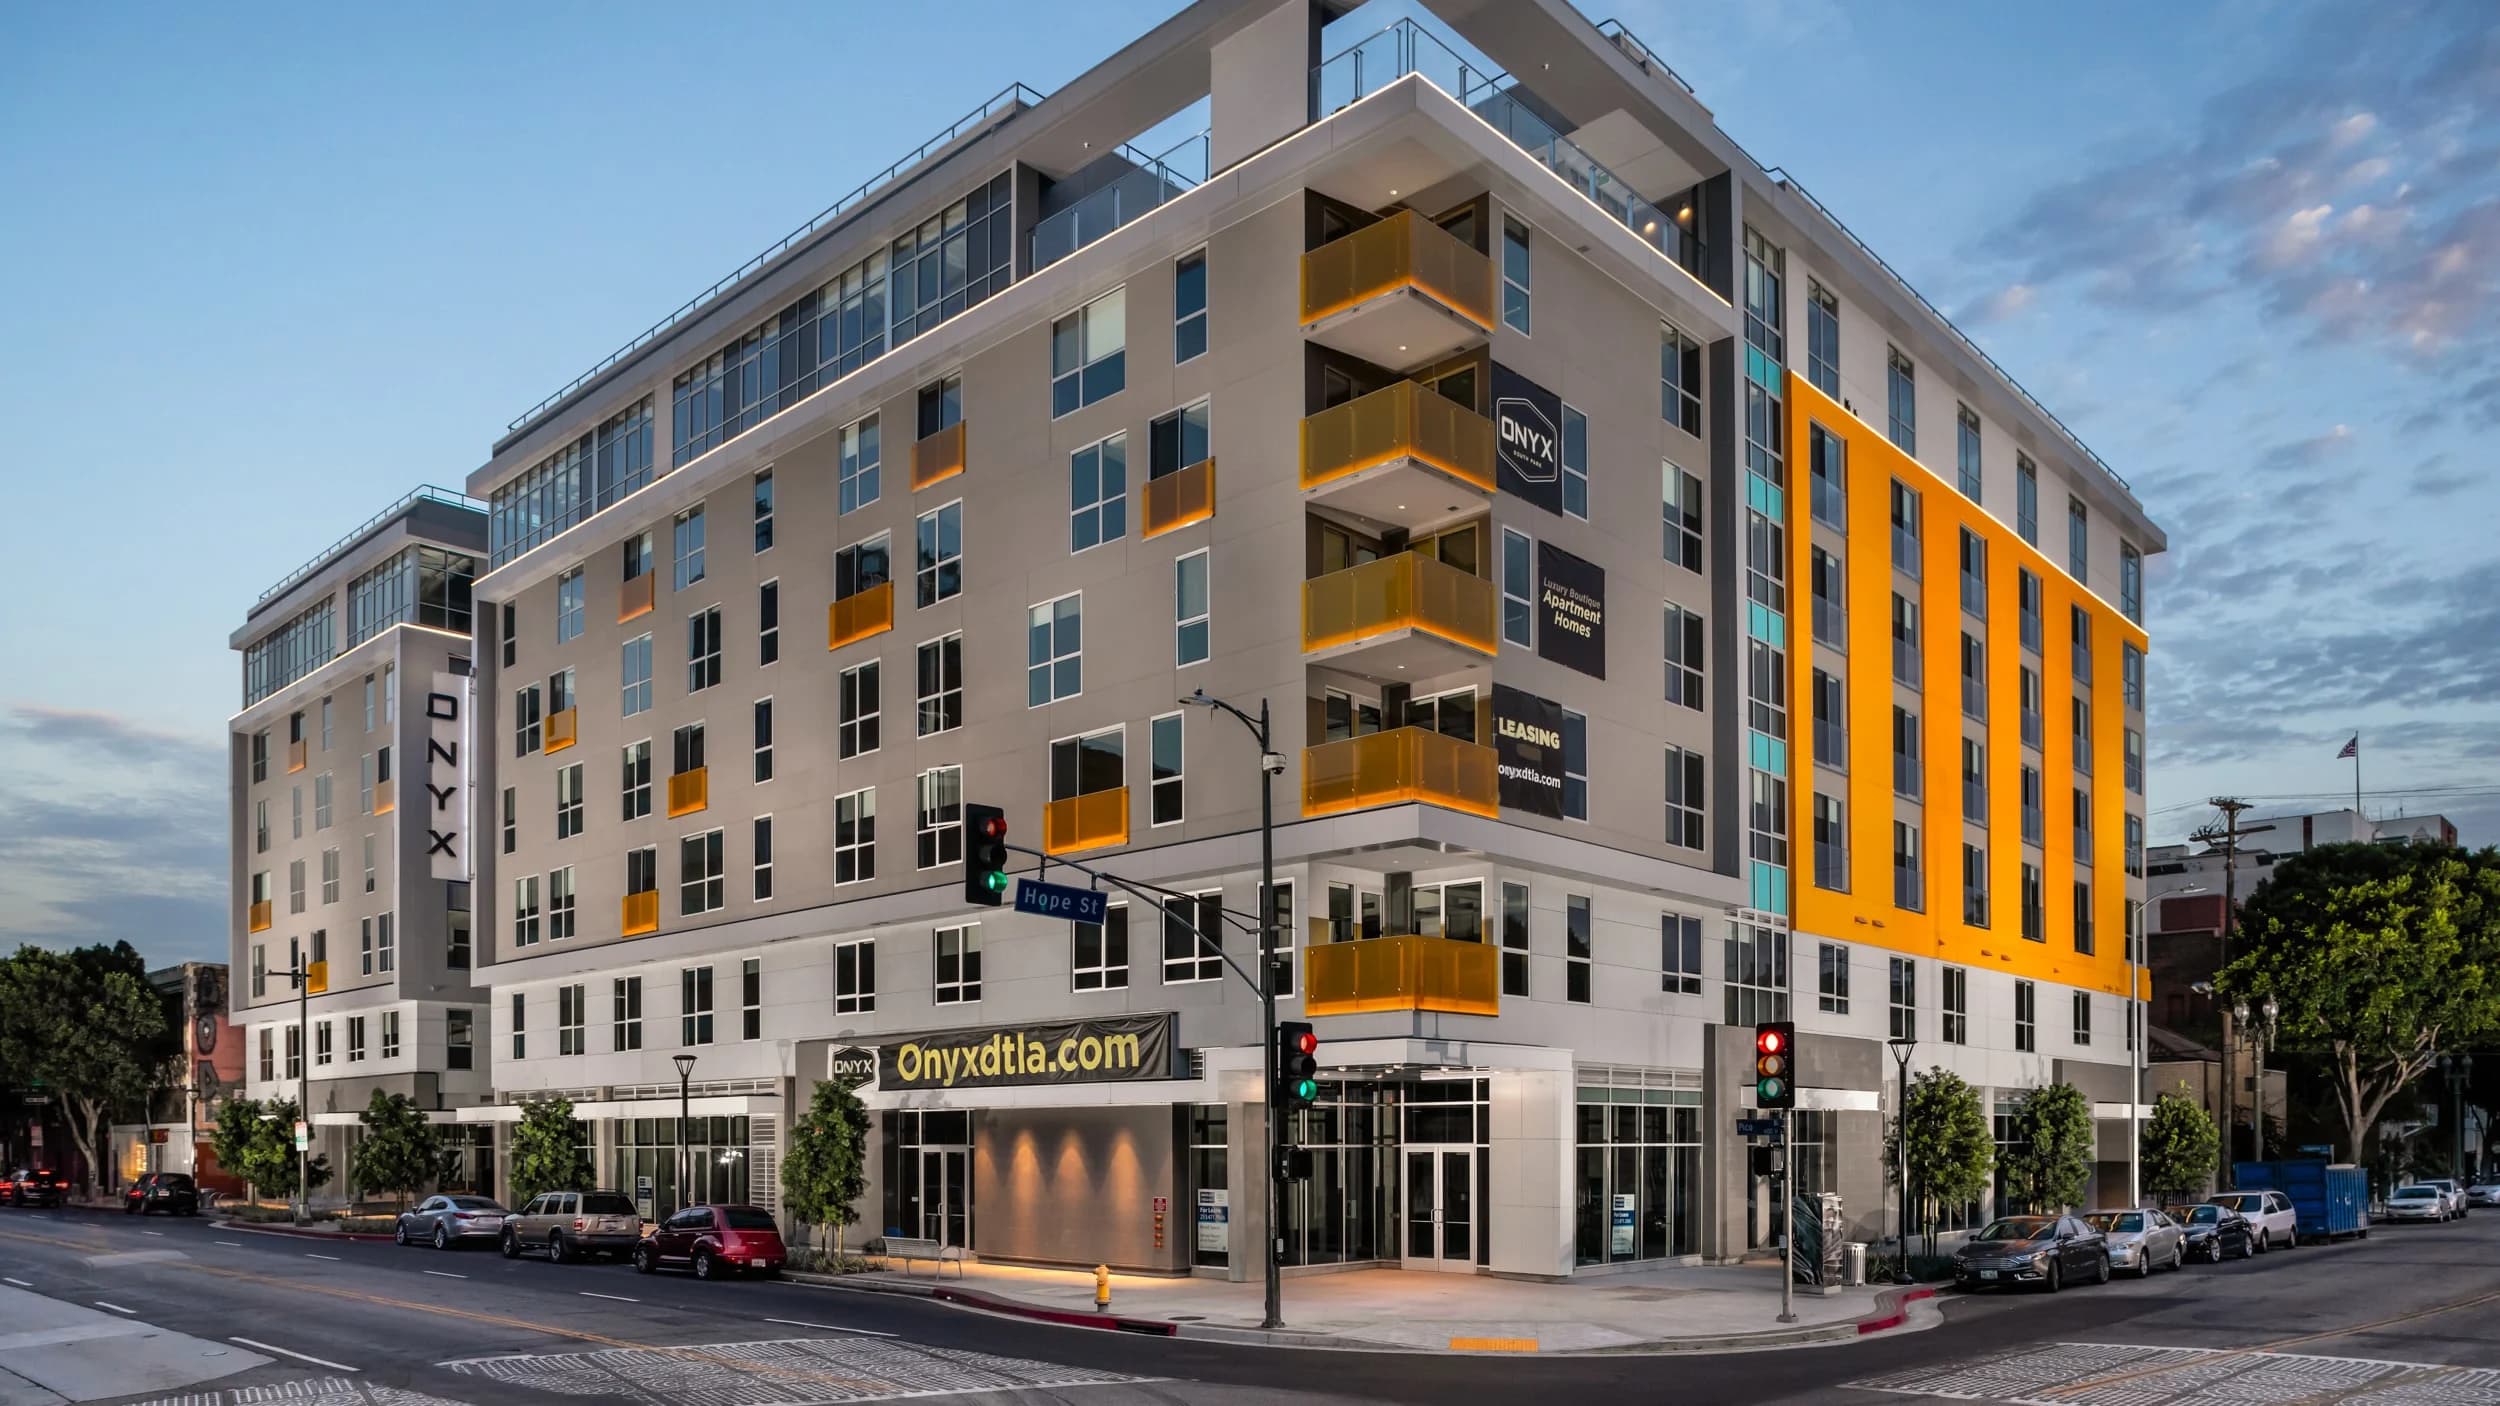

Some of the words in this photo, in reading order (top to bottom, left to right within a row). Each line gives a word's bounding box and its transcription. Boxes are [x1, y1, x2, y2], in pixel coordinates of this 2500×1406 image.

[1501, 415, 1553, 463] ONYX
[1513, 450, 1529, 462] SOUTH
[1530, 458, 1542, 468] PARK
[1542, 590, 1601, 625] Apartment
[1543, 576, 1568, 596] Luxury
[1569, 588, 1601, 609] Boutique
[1554, 610, 1591, 638] Homes
[1498, 716, 1560, 750] LEASING
[426, 692, 458, 857] ONYX
[1498, 764, 1561, 788] onyxdtla.com
[1024, 887, 1071, 911] Hope
[1080, 896, 1099, 915] St
[834, 1059, 873, 1074] ONYX
[897, 1031, 1139, 1087] Onyxdtla.com
